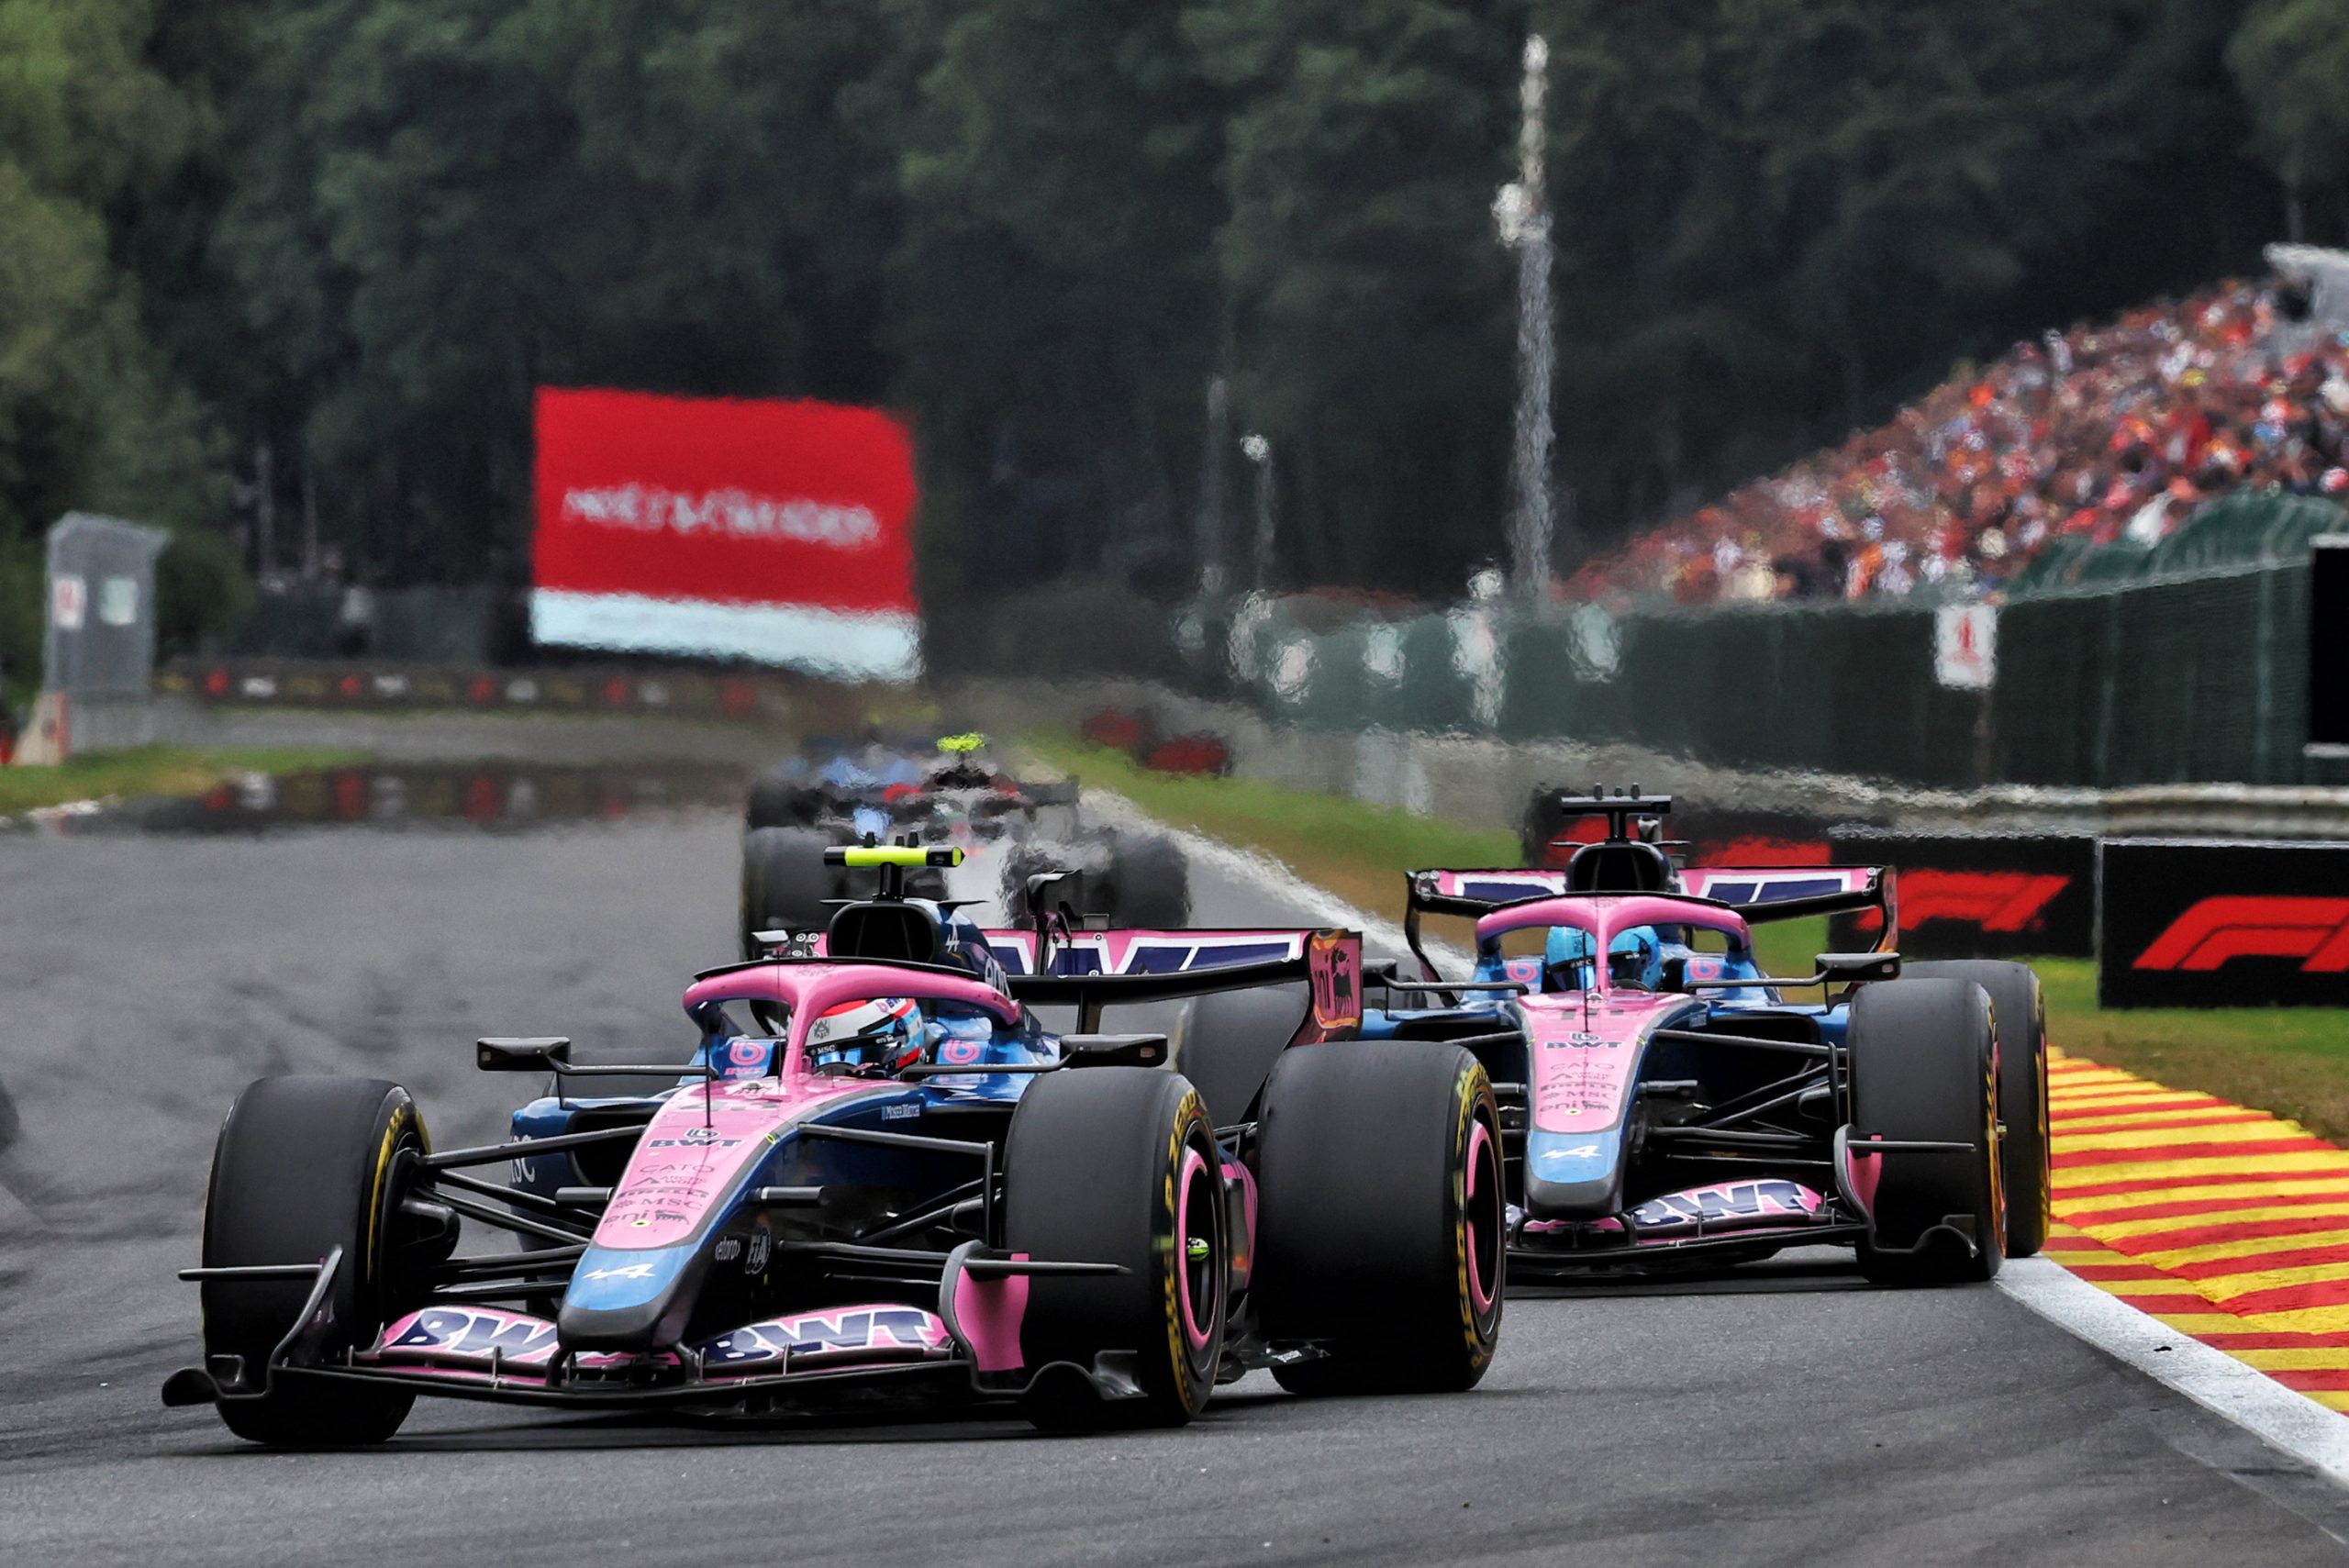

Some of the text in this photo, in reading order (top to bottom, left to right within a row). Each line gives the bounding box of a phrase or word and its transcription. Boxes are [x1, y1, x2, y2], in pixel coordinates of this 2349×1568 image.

[817, 1044, 836, 1055] MSC
[1565, 1090, 1617, 1100] MSC
[1539, 1100, 1577, 1112] eni
[647, 1139, 743, 1148] BWT
[641, 1197, 703, 1210] MSC
[1631, 1181, 1802, 1228] BWT
[603, 1209, 650, 1224] eni
[392, 1309, 559, 1362] BW
[697, 1310, 930, 1364] BWT
